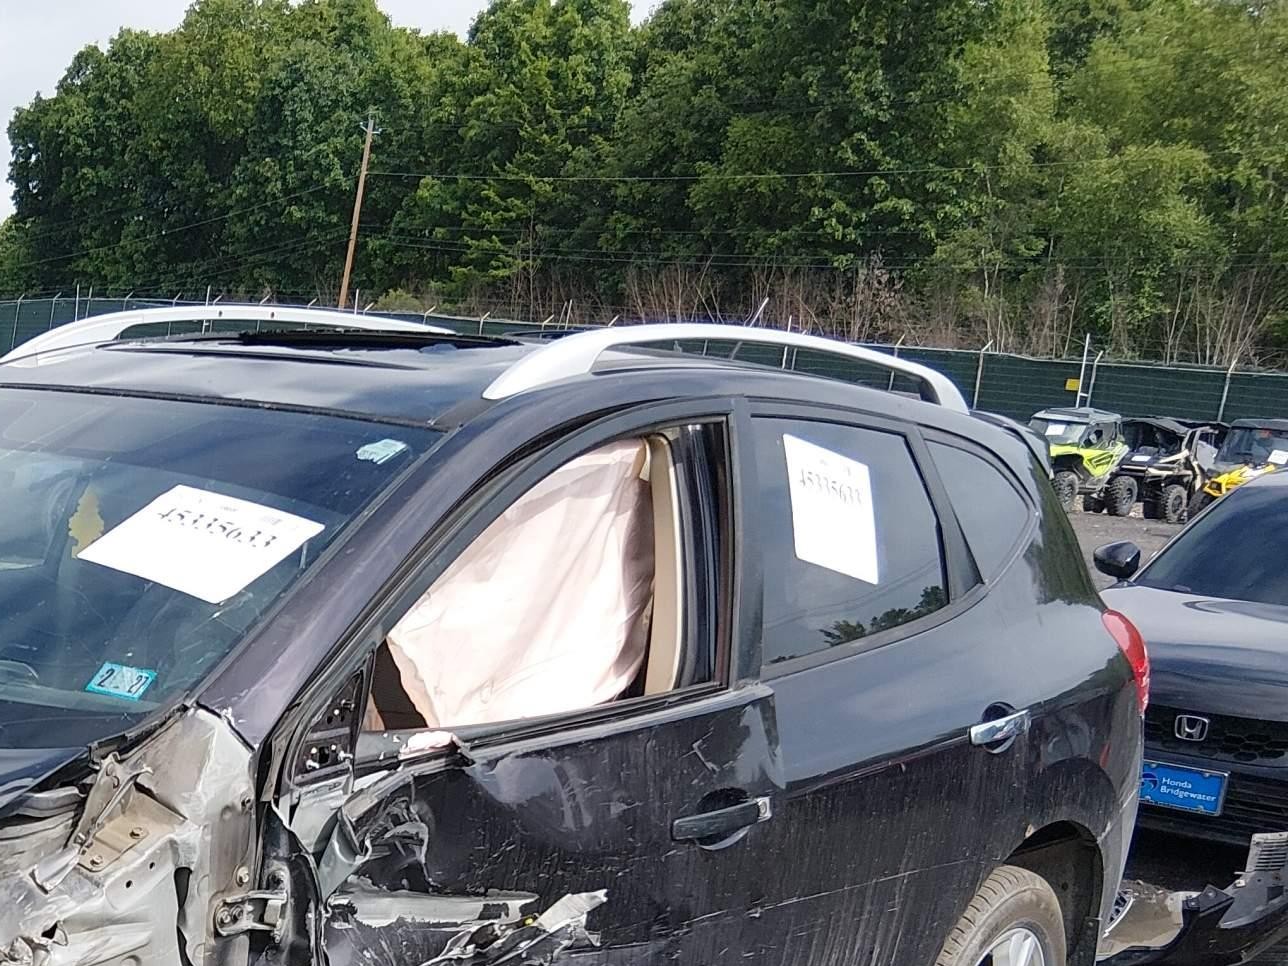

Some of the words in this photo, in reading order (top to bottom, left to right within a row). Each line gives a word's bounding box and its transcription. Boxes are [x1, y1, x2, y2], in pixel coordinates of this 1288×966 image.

[158, 508, 277, 547] 45335633
[97, 668, 115, 687] 2
[127, 675, 149, 695] 27
[1160, 785, 1216, 801] Bridgewater
[1161, 777, 1192, 789] Honda
